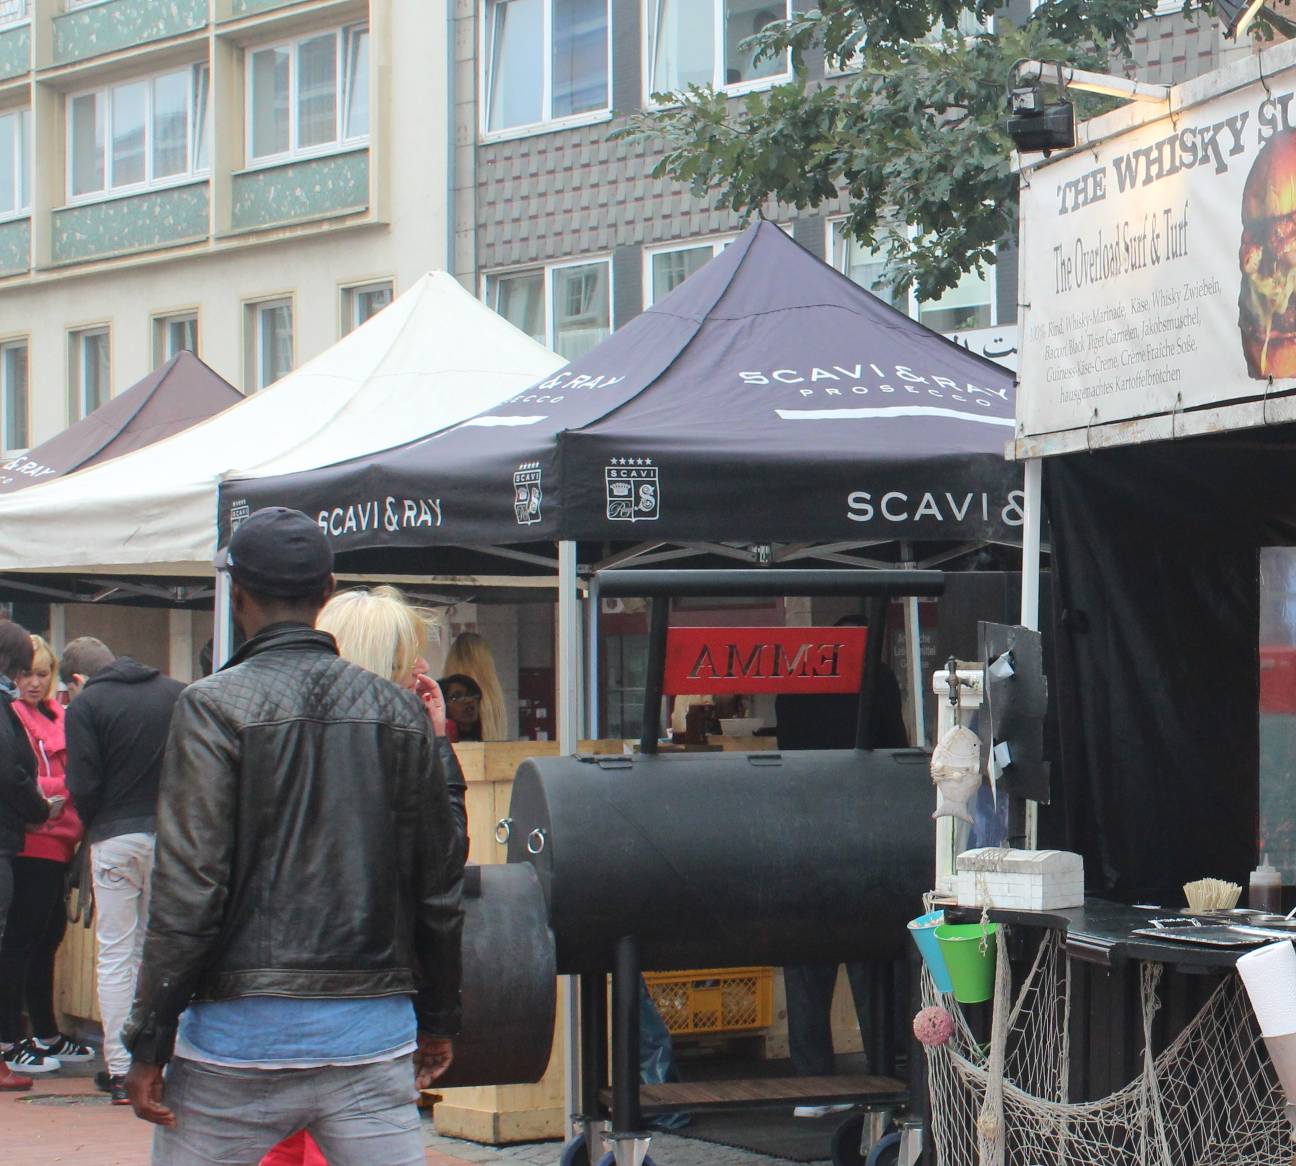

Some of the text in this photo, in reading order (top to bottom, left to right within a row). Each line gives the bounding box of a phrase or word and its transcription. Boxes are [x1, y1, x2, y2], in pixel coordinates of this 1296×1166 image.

[1056, 167, 1107, 216] THE
[1112, 111, 1250, 193] WHISKY
[1053, 201, 1189, 294] The Overload Surf & Turf
[561, 375, 626, 390] RAY
[738, 363, 886, 385] SCAVI
[930, 374, 1009, 401] RAY
[800, 384, 992, 407] PROSECCO
[609, 469, 655, 478] SCAVI
[317, 497, 381, 537] SCAVI
[402, 498, 442, 529] RAY
[847, 490, 989, 522] SCAVI
